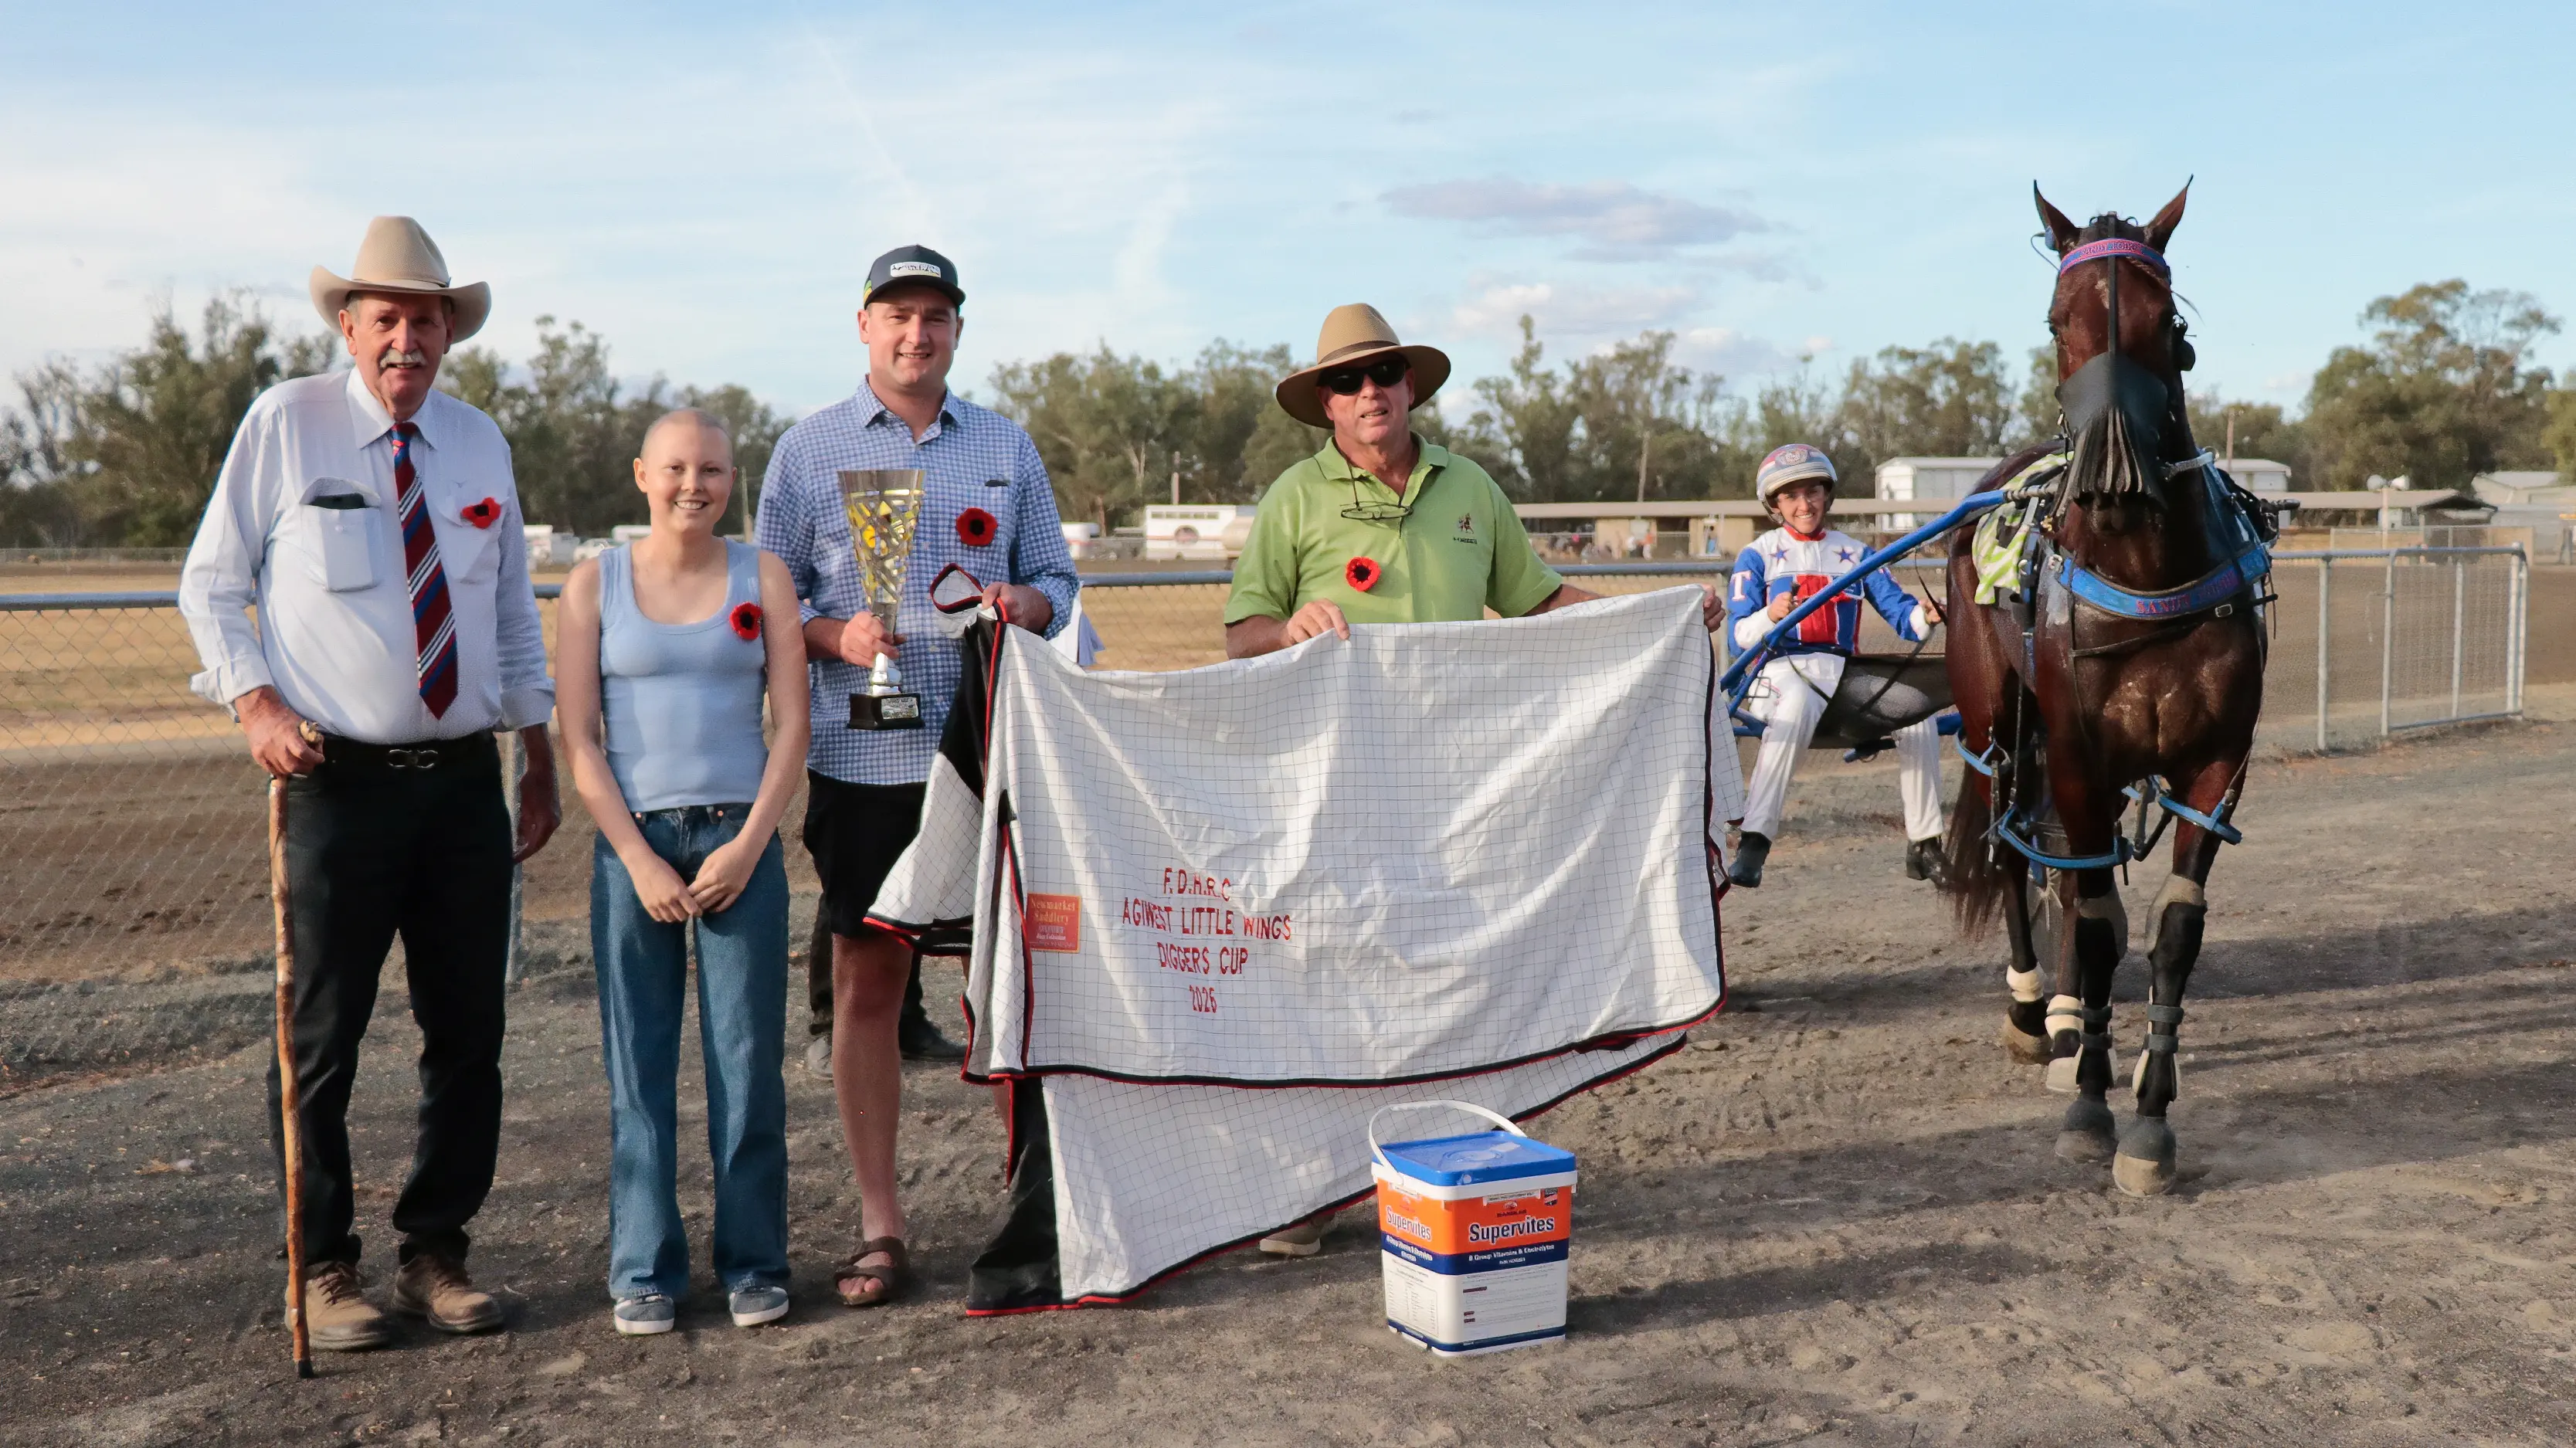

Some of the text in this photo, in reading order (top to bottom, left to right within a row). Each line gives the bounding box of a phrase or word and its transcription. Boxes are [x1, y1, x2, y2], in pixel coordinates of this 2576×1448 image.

[1731, 570, 1752, 601] T
[1181, 907, 1234, 934] LITTLE
[1243, 914, 1292, 941] WINGS
[1157, 941, 1249, 975] DIGGERS CUP
[1386, 1205, 1433, 1242] Supervites
[1469, 1215, 1555, 1245] Supervites
